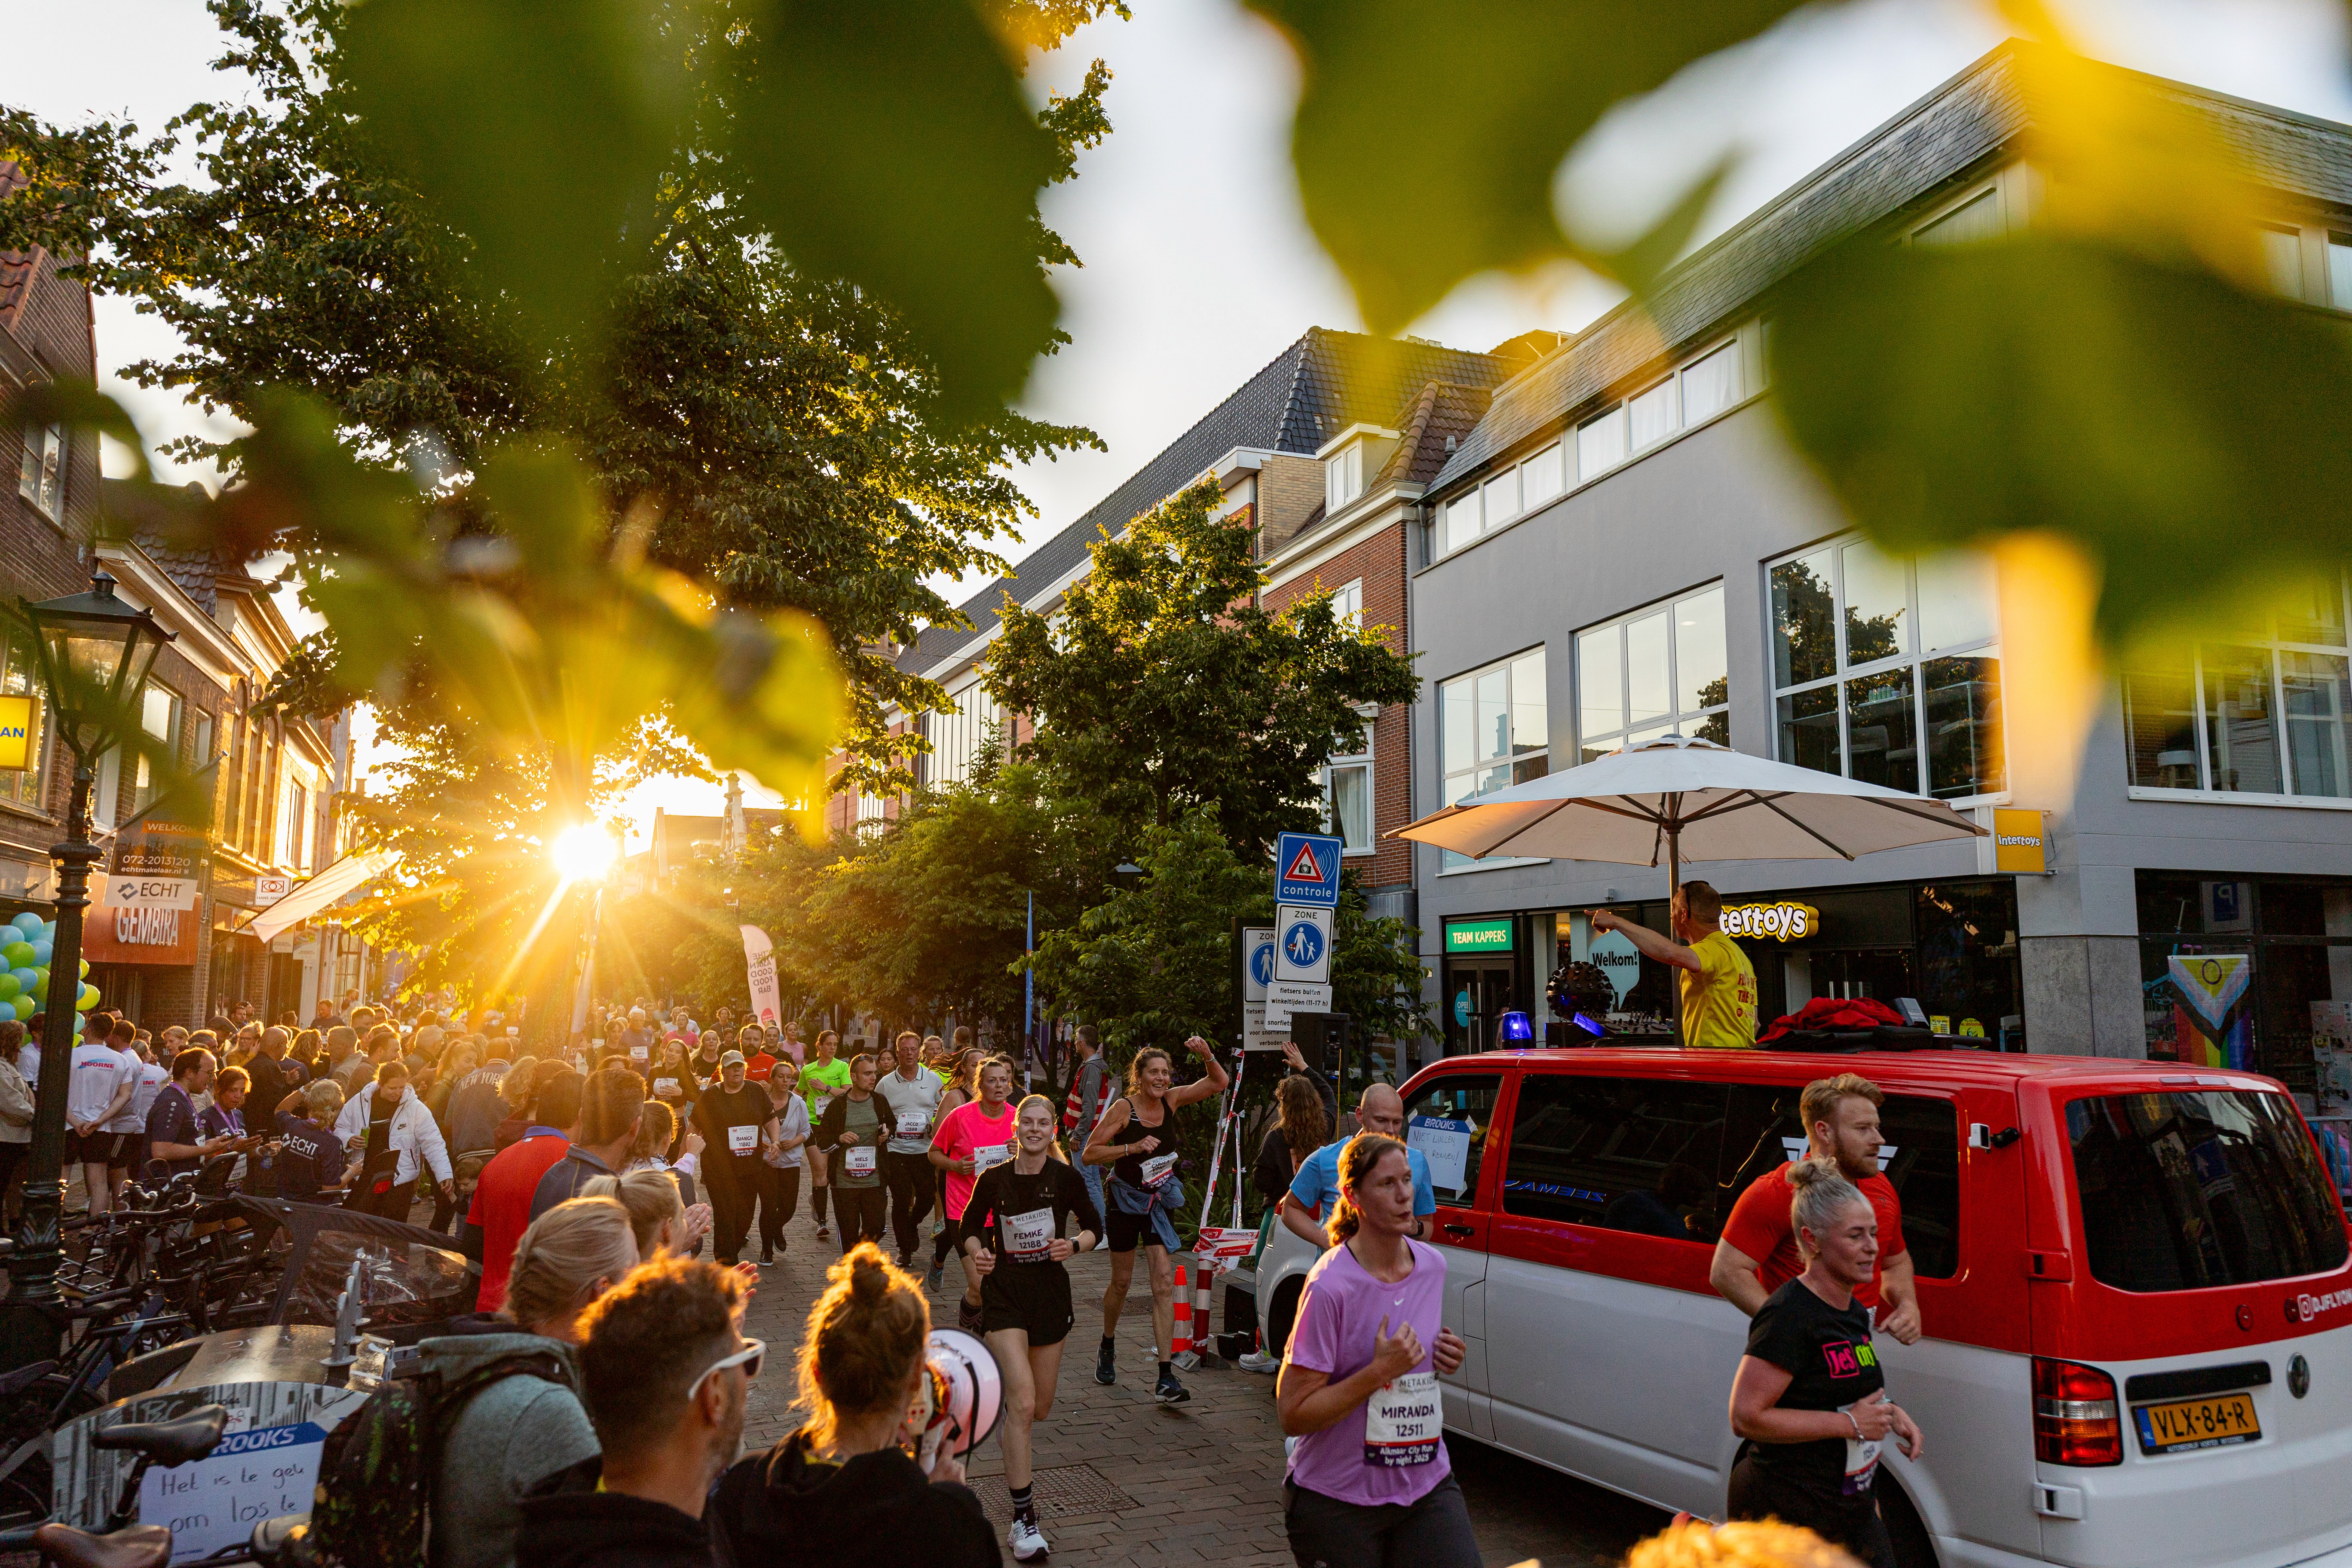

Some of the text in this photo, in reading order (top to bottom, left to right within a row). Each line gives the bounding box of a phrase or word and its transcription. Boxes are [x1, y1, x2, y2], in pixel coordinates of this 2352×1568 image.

[1997, 833, 2041, 848] Intertoys
[123, 855, 190, 867] 072-2013120
[121, 866, 181, 875] echtmakelaar.nl
[140, 882, 182, 898] ECHT
[1283, 886, 1332, 897] controle
[1295, 911, 1317, 919] ZONE
[1719, 906, 1806, 938] tertoys
[117, 907, 179, 946] GEMBIRA
[1453, 930, 1506, 944] TEAM KAPPERS
[1592, 951, 1638, 966] Welkom!
[459, 1072, 501, 1093] NEW YOR
[1424, 1118, 1457, 1130] BROOKS
[1413, 1130, 1431, 1142] NIET
[291, 1136, 318, 1155] ECHT
[1016, 1211, 1047, 1223] METAKIDS
[1014, 1228, 1043, 1240] FEMKE
[1019, 1240, 1042, 1249] 12188
[1381, 1403, 1435, 1418] MIRANDA
[2154, 1401, 2249, 1438] VLX-84-R
[1396, 1423, 1423, 1437] 12511
[211, 1427, 297, 1455] ROOKS
[1380, 1445, 1433, 1455] Alkmaar City Run
[1385, 1454, 1429, 1467] by night 2025
[161, 1472, 197, 1496] Het
[213, 1476, 230, 1486] is
[171, 1513, 209, 1533] om
[232, 1496, 270, 1523] los
